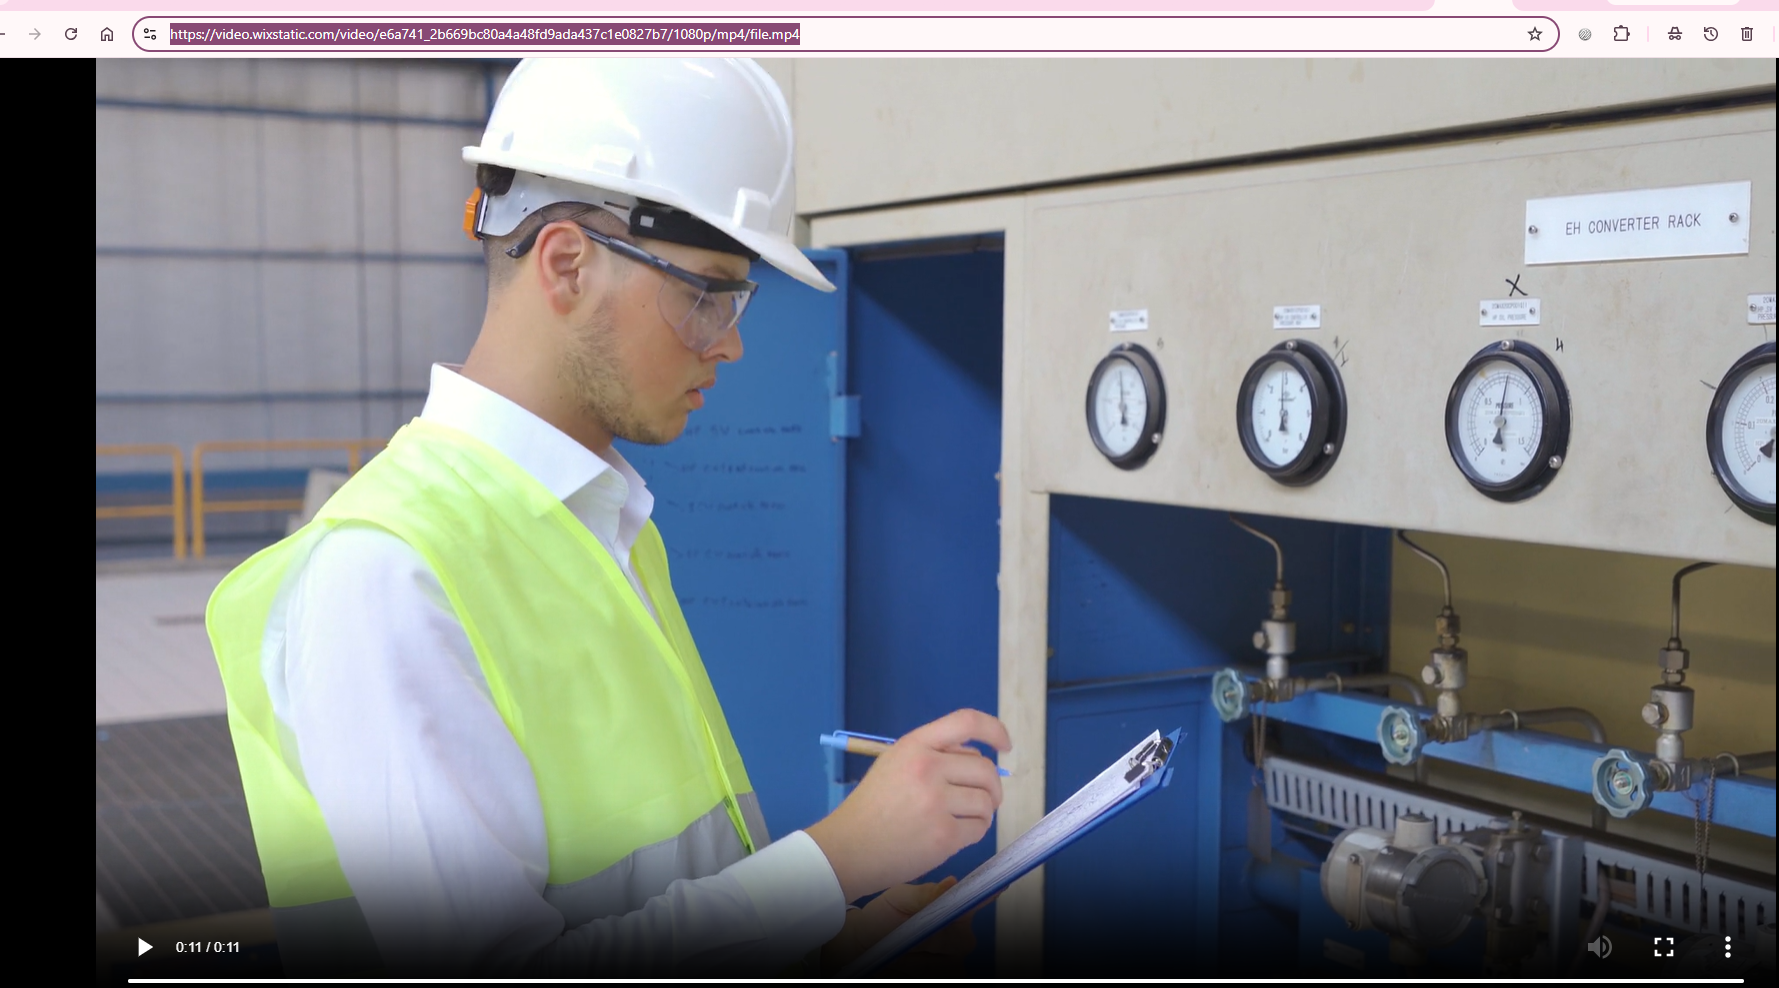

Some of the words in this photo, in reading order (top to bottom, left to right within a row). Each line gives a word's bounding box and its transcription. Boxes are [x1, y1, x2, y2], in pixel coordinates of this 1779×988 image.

[170, 28, 800, 43] https://video.wixstatic.com/video/e6a741_2b669bc80a4a48fd9ada437c1e0827b7/1080p/mp4/file.mp4
[1565, 222, 1581, 235] EH
[1588, 216, 1660, 234] CONVERTER
[1668, 213, 1702, 229] RACK
